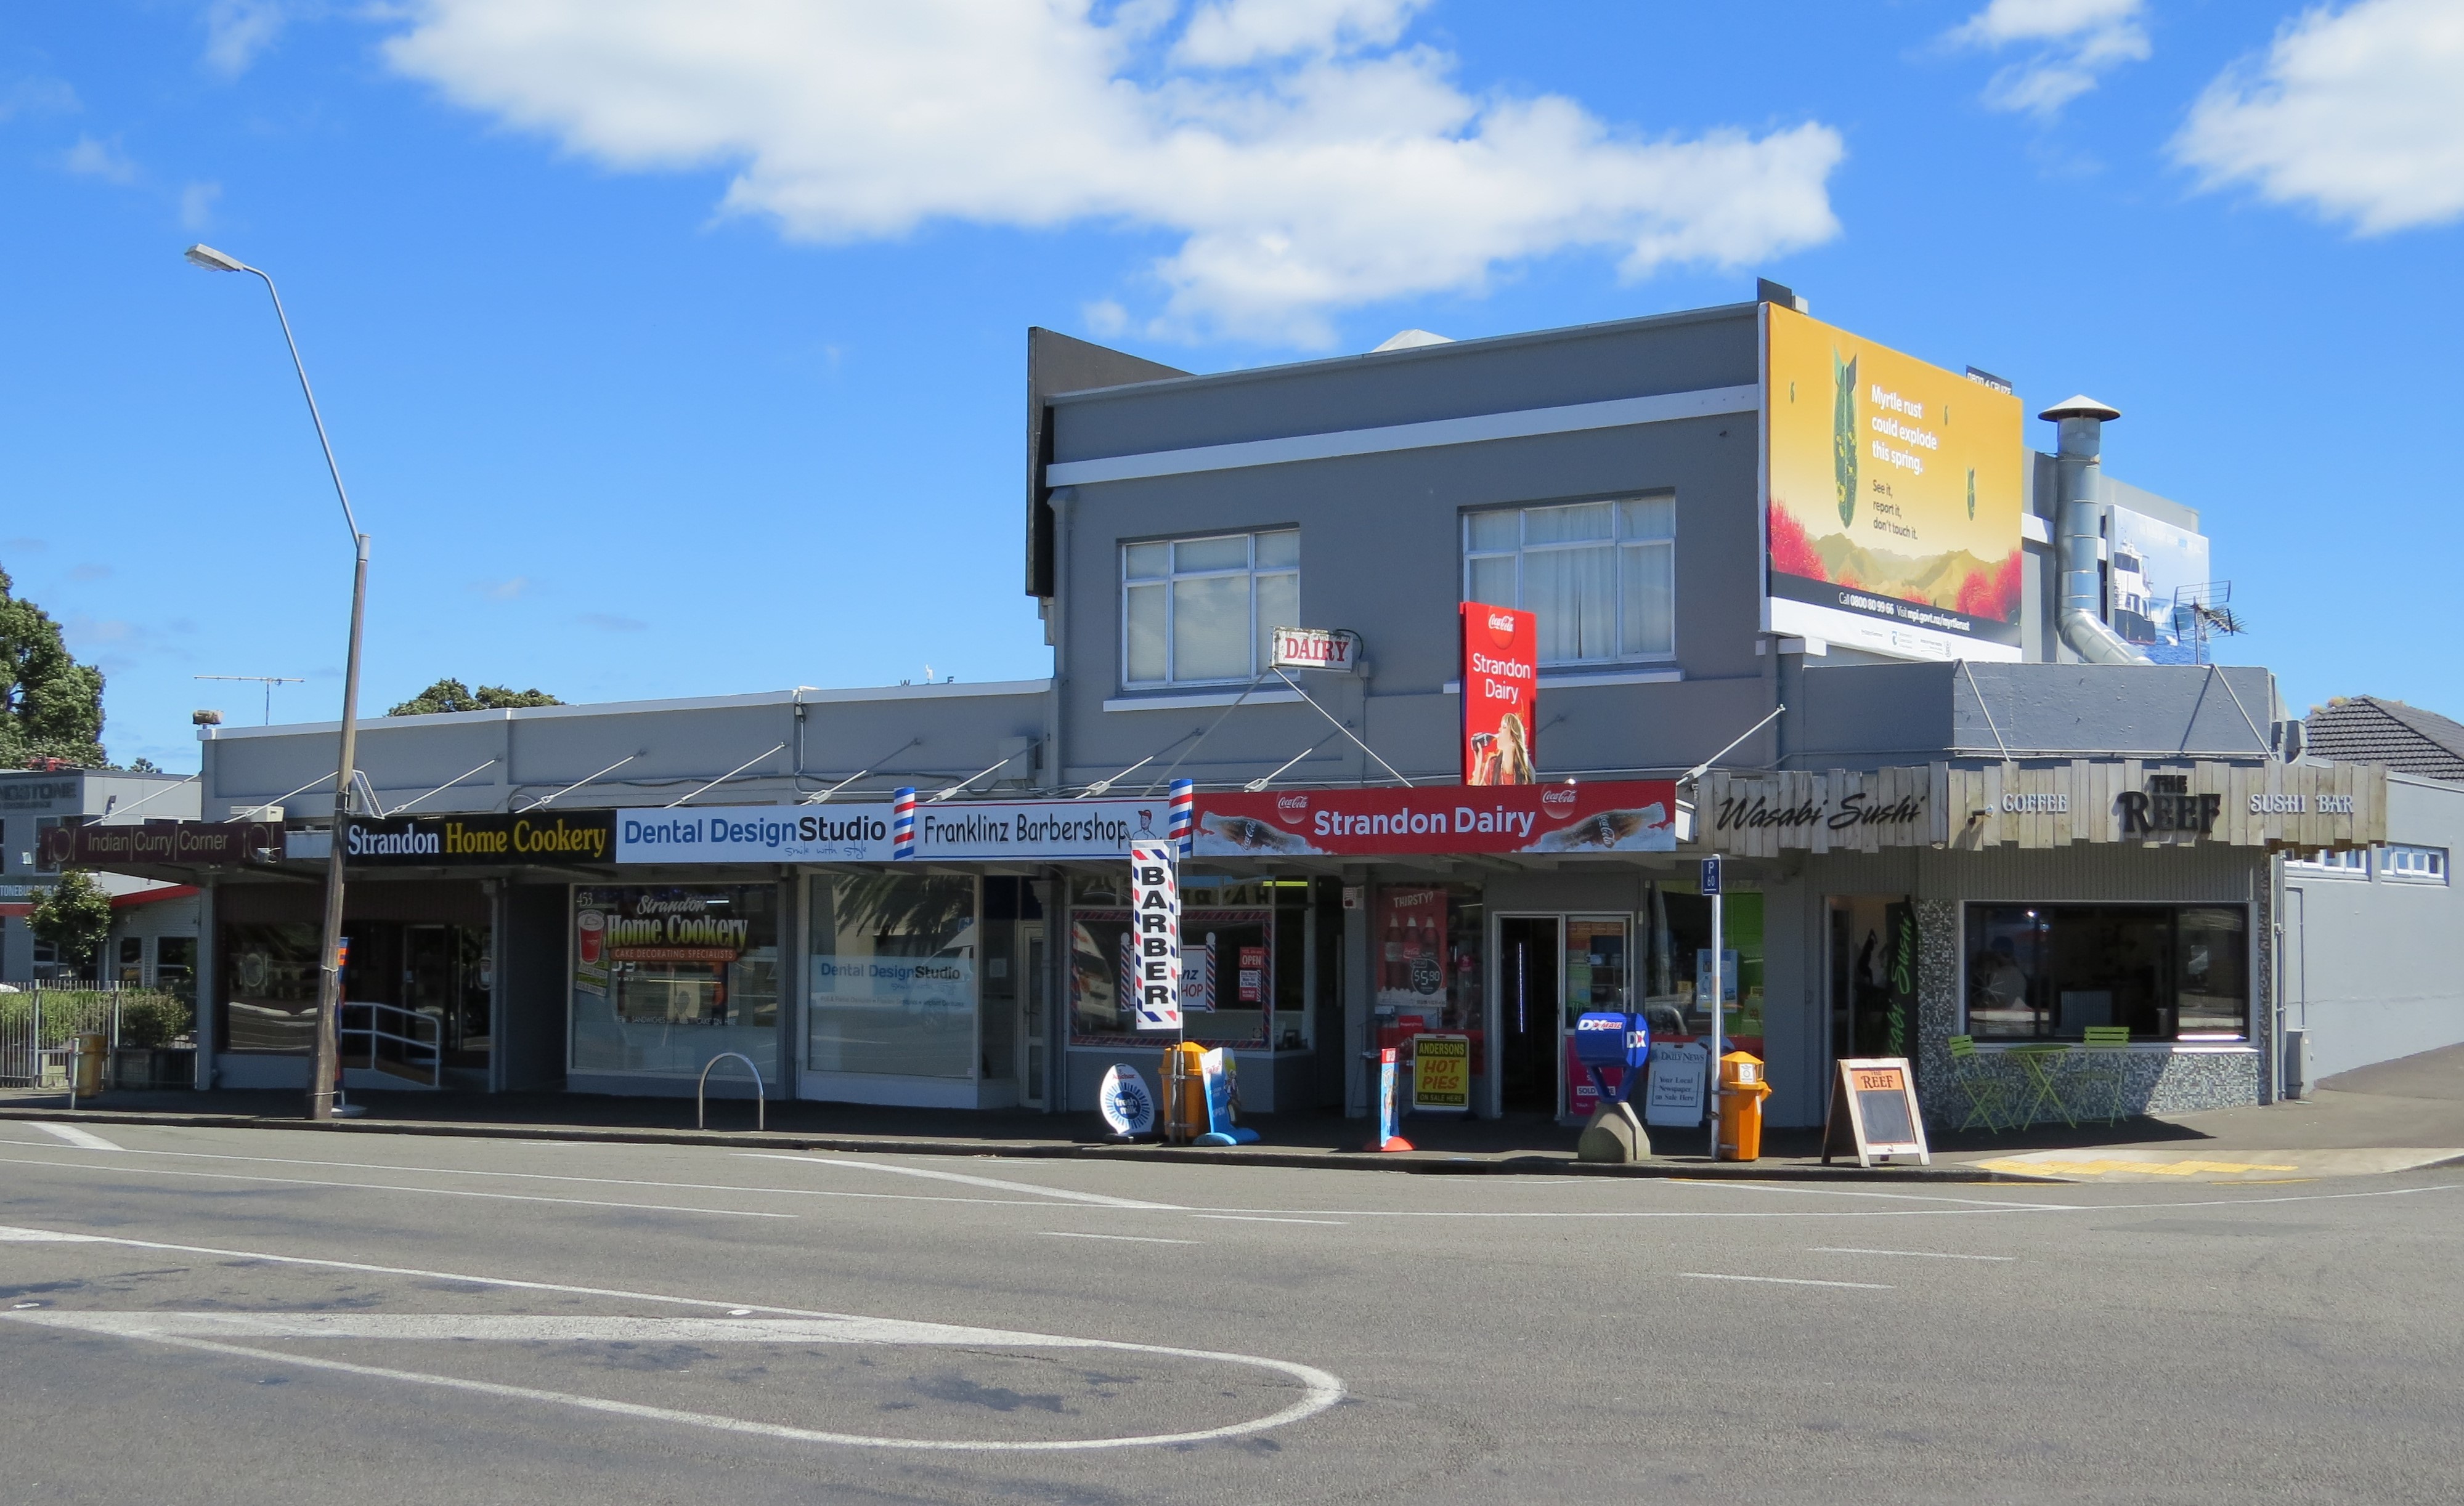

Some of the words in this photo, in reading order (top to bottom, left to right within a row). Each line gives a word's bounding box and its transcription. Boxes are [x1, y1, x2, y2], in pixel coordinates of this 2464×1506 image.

[1871, 384, 1902, 410] Myrtle
[1904, 400, 1922, 419] rust
[1871, 416, 1898, 438] could
[1900, 427, 1937, 450] explode
[1872, 440, 1890, 461] this
[1891, 450, 1923, 476] spring.
[1872, 479, 1885, 494] See
[1873, 501, 1894, 515] report
[1873, 517, 1892, 533] don't
[1892, 522, 1910, 538] touch
[1839, 592, 1850, 605] Call
[1850, 596, 1867, 609] 0800
[1868, 599, 1877, 611] 80
[1877, 601, 1885, 613] 99
[1885, 603, 1894, 615] 66
[1897, 604, 1908, 618] Visit
[1285, 638, 1348, 662] DAIRY
[1473, 653, 1531, 679] Strandon
[1485, 679, 1519, 705] Dairy
[2150, 775, 2187, 793] THE
[1717, 796, 1828, 830] Wasabi
[1827, 793, 1925, 830] Sushi
[2002, 793, 2068, 813] COFFEE
[2117, 791, 2221, 833] REEF
[2250, 794, 2306, 813] SUSHI
[2316, 795, 2354, 813] BAR
[925, 814, 1009, 844] Franklinz
[1017, 812, 1128, 848] Barbershop
[1314, 808, 1446, 836] Strandon
[1455, 805, 1535, 838] Dairy
[348, 823, 439, 855] Strandon
[446, 822, 507, 853] Home
[514, 819, 606, 857] Cookery
[625, 819, 702, 844] Dental
[88, 833, 129, 851] Indian
[134, 831, 173, 856] Curry
[180, 830, 228, 851] Corner
[1709, 862, 1714, 874] P
[1707, 875, 1715, 886] 60
[577, 893, 593, 906] 453
[636, 895, 707, 915] Strandon
[1393, 891, 1434, 908] THIRSTY?
[606, 915, 662, 947] Home
[667, 915, 748, 952] Cookery
[1142, 867, 1169, 1004] BARBER
[615, 949, 633, 958] CAKE
[637, 949, 684, 958] DECORATING
[689, 950, 733, 959] SPECIALISTS
[1242, 955, 1261, 965] OPEN
[821, 963, 864, 976] Dental
[1578, 1019, 1608, 1030] DX
[1627, 1030, 1646, 1048] DX
[1418, 1043, 1465, 1055] ANDERSONS
[1661, 1052, 1683, 1060] DAILY
[1683, 1053, 1704, 1061] NEWS
[1424, 1059, 1460, 1073] HOT
[1422, 1075, 1460, 1089] PIES
[1659, 1085, 1691, 1093] Newspaper
[1861, 1075, 1893, 1088] REEF
[1115, 1097, 1138, 1106] fresh
[1120, 1106, 1139, 1115] milk
